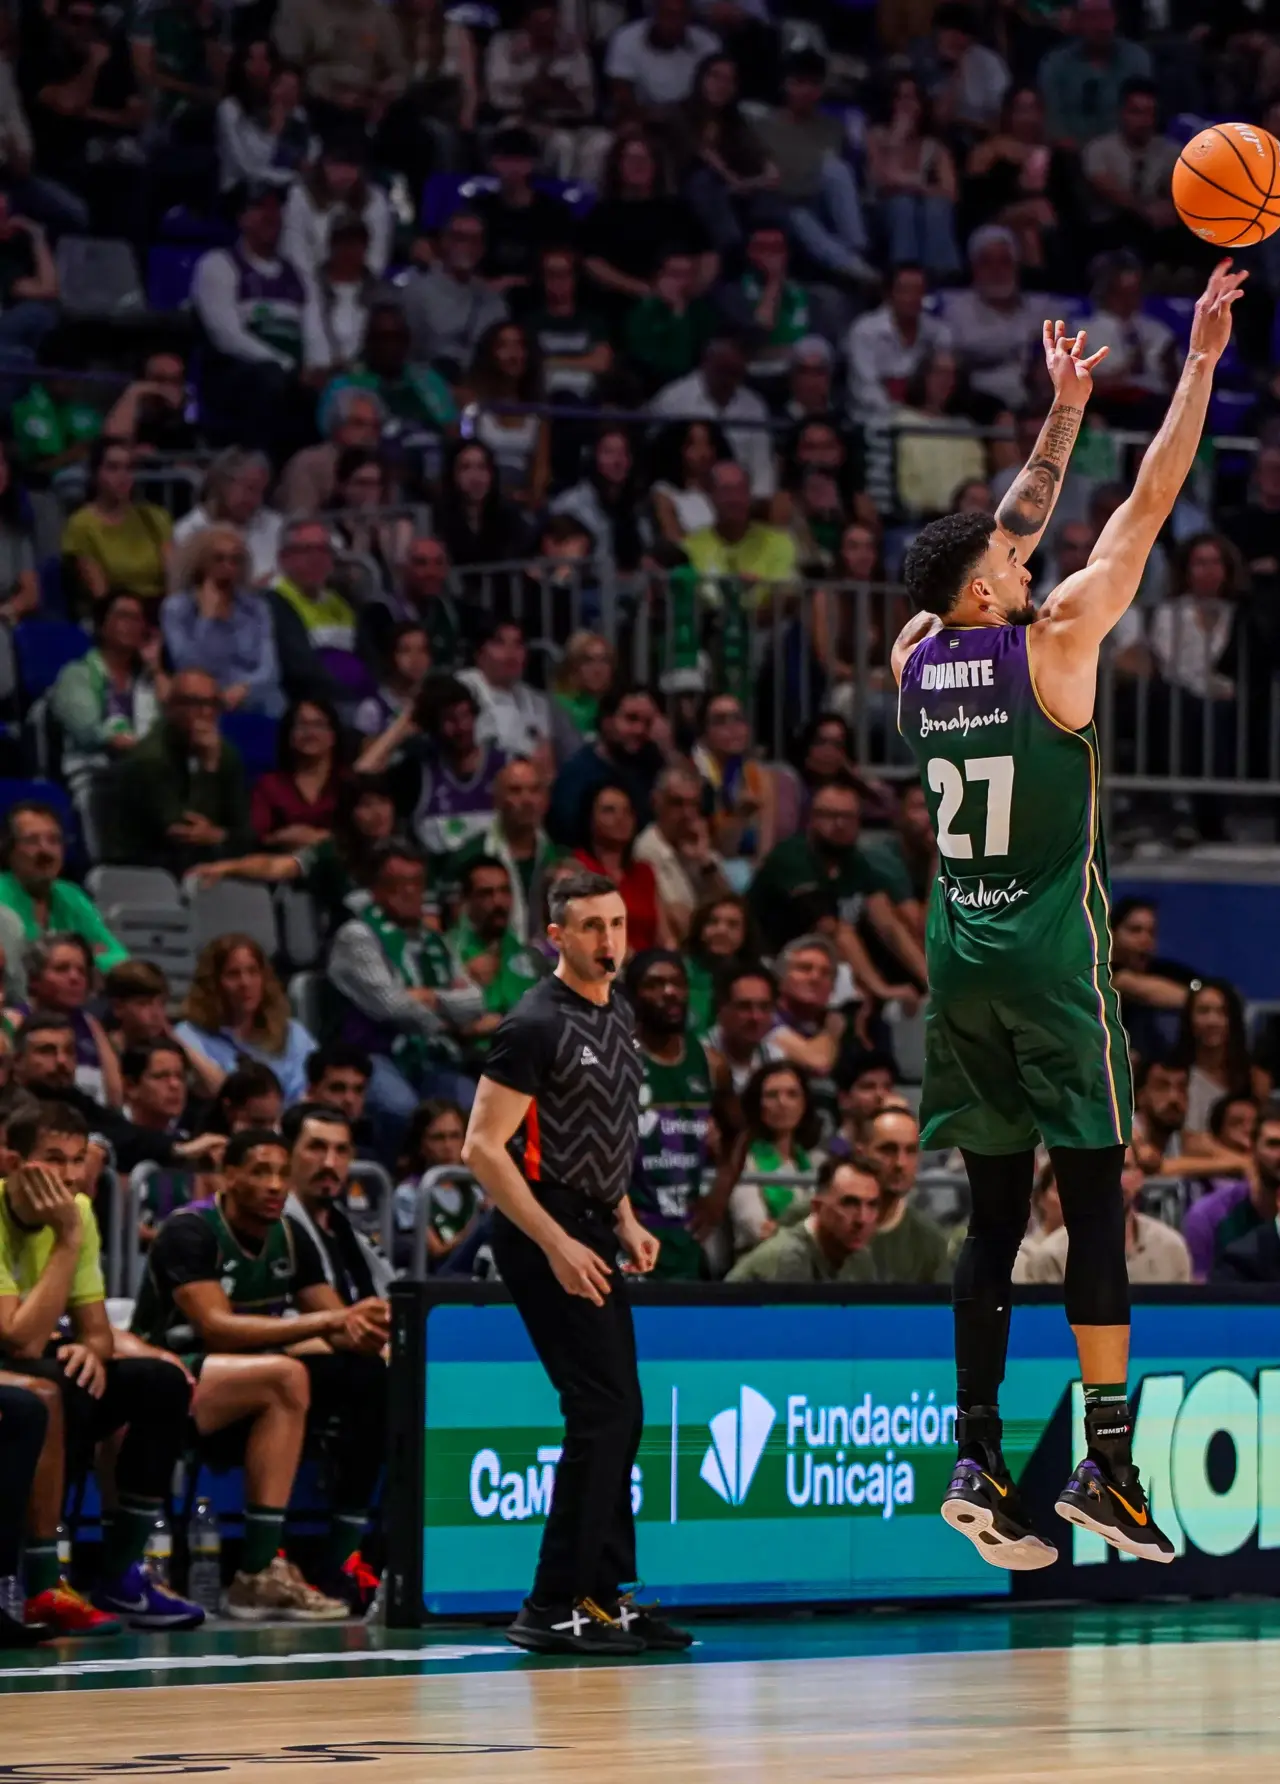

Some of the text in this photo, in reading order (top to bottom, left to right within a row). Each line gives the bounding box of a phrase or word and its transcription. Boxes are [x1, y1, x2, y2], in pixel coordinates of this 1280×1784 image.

[921, 659, 994, 690] DUARTE
[927, 755, 1014, 859] 27
[786, 1390, 958, 1448] Fundación
[786, 1451, 915, 1520] Unicaja
